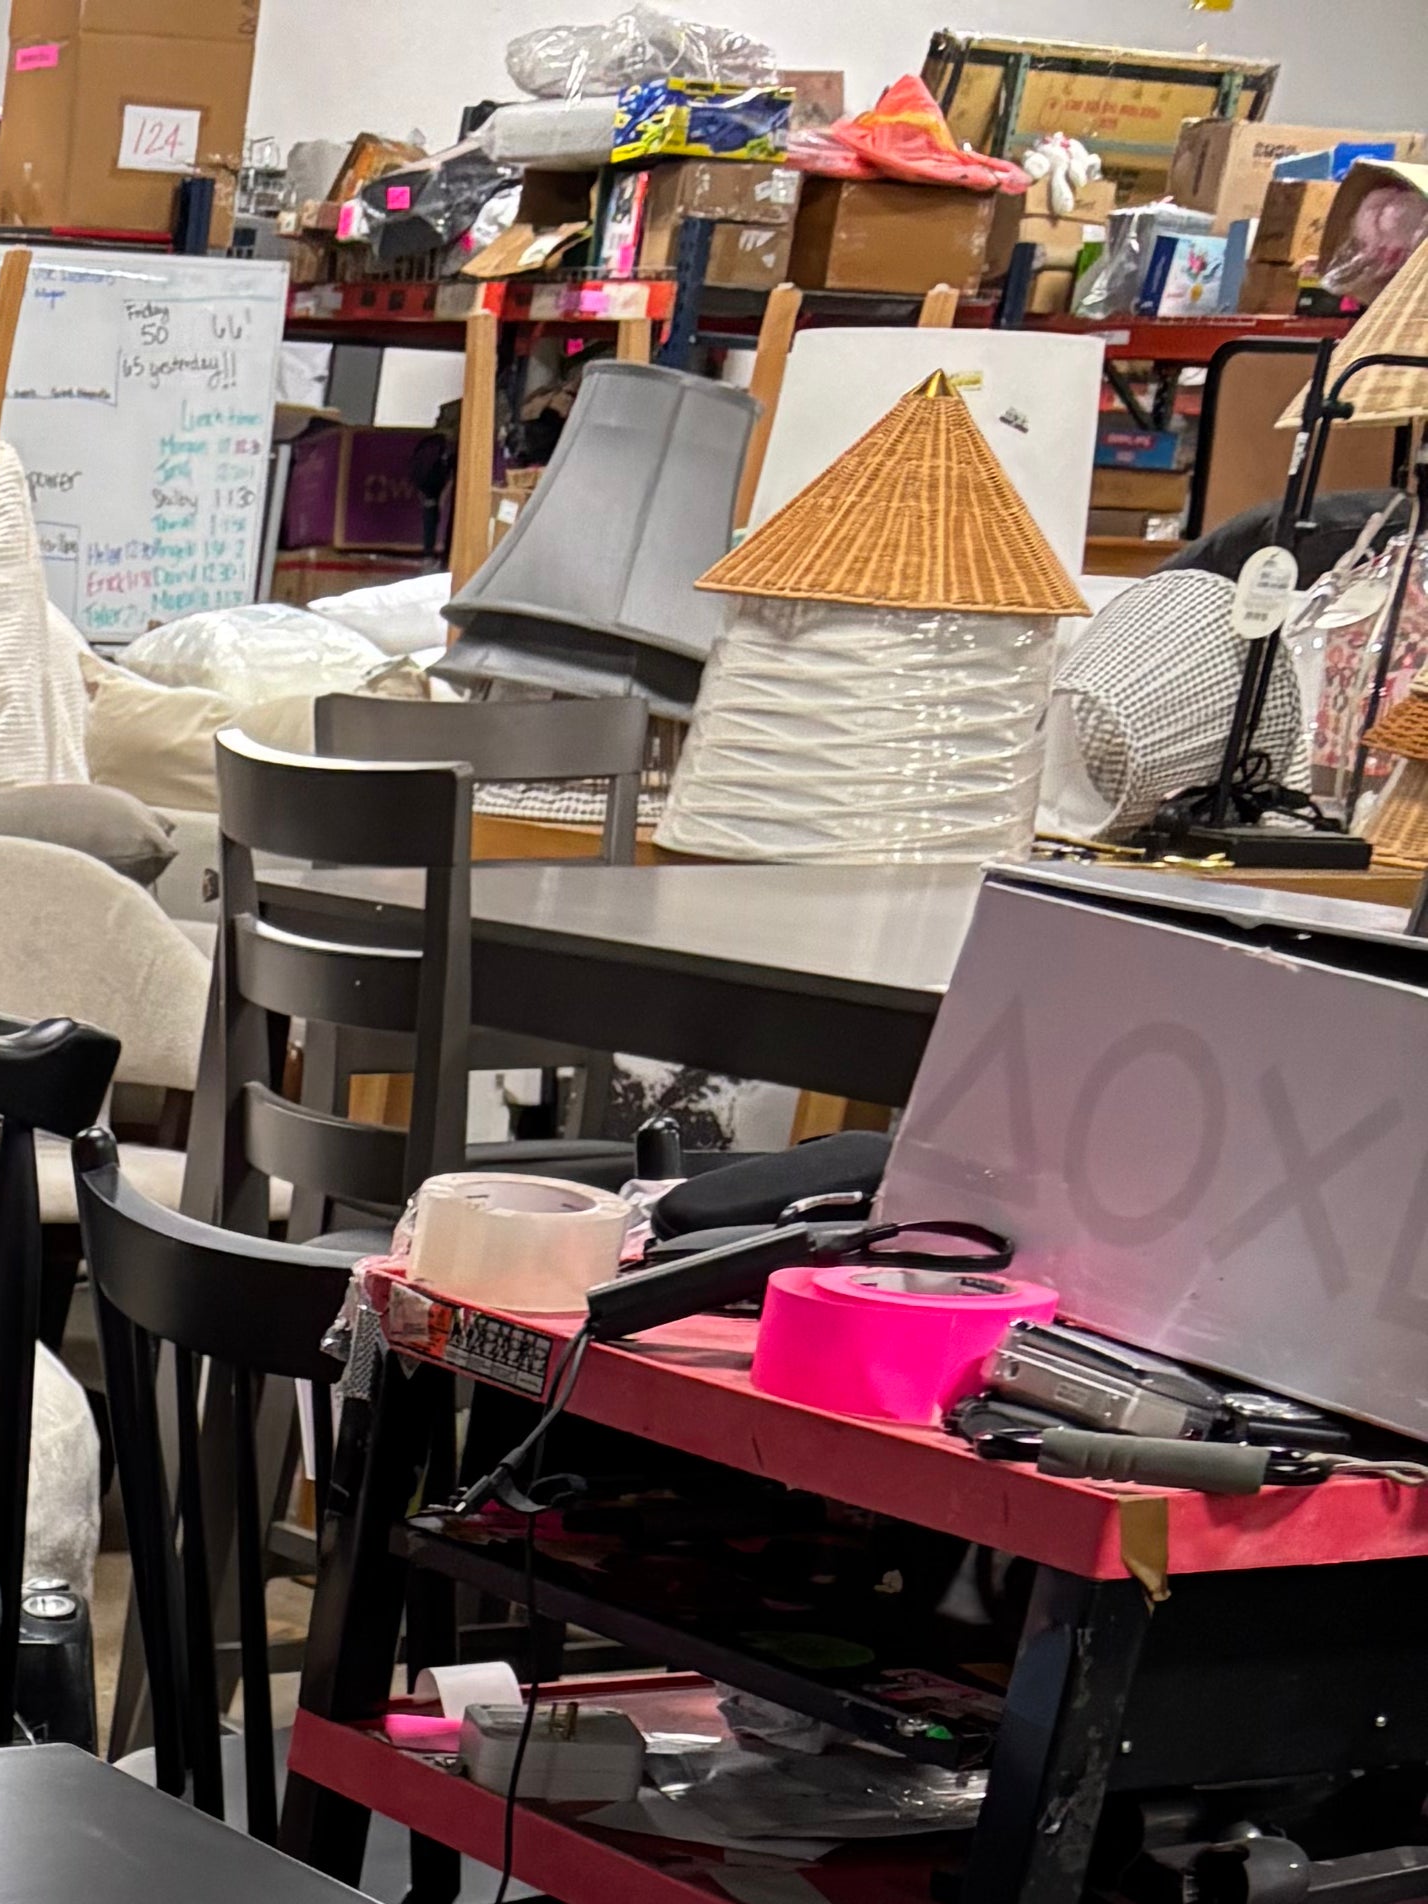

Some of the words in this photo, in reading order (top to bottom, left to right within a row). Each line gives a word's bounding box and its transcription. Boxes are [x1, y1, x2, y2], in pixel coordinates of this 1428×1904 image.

[134, 118, 184, 158] 124
[125, 303, 170, 325] Friday
[140, 324, 169, 347] 50
[123, 354, 145, 379] 65
